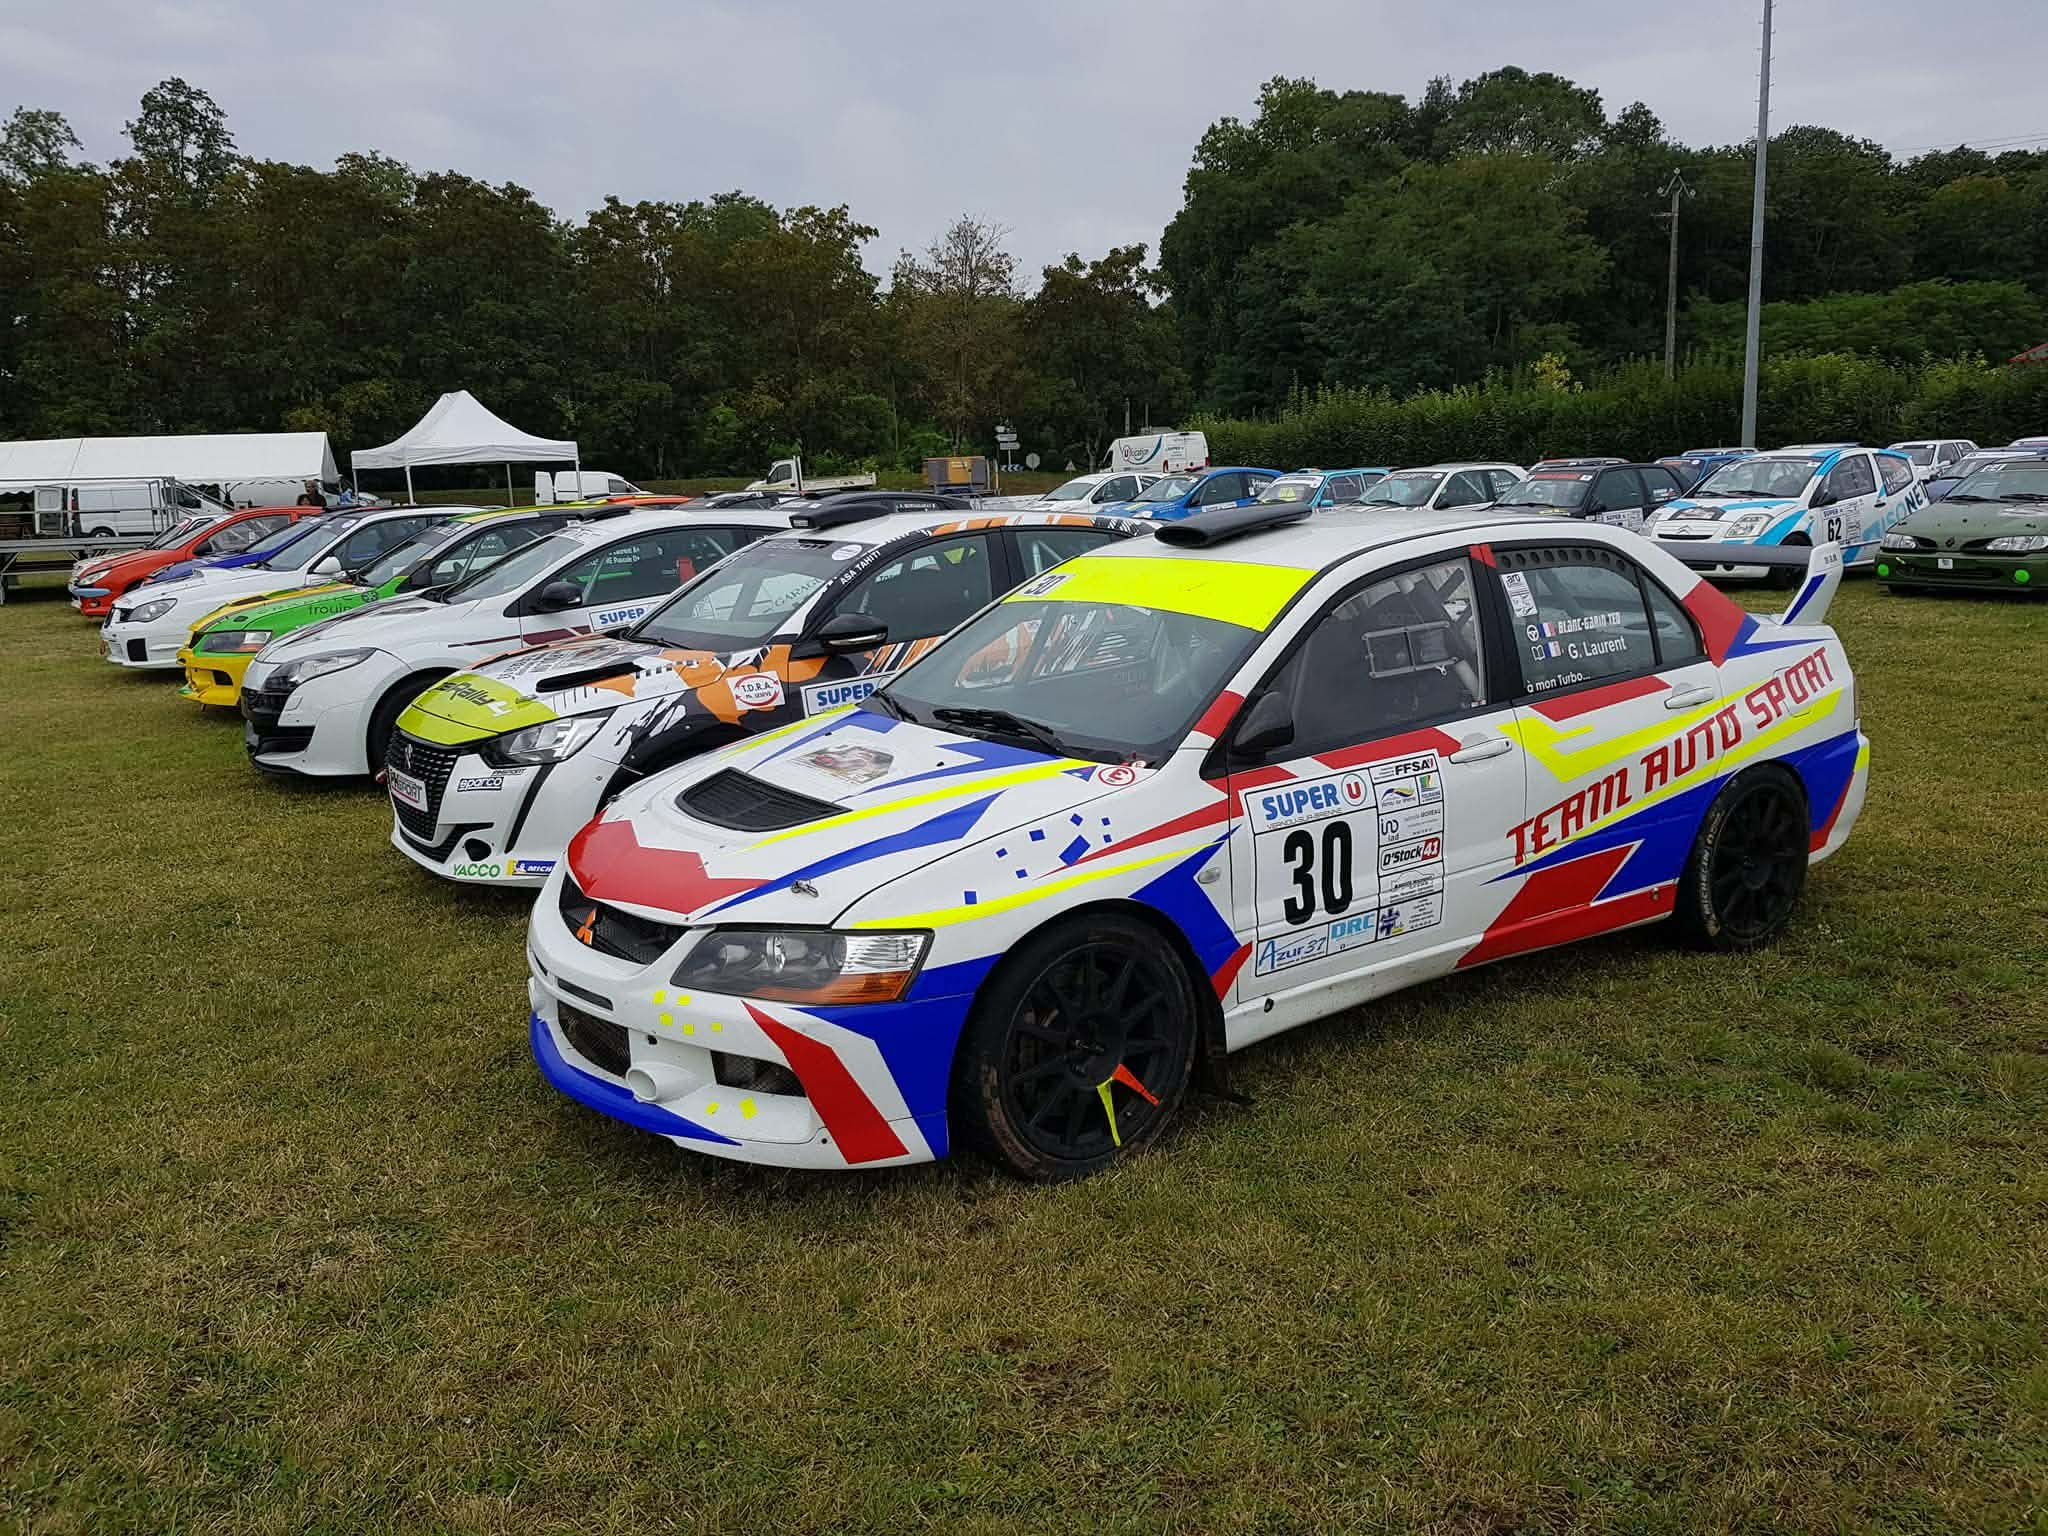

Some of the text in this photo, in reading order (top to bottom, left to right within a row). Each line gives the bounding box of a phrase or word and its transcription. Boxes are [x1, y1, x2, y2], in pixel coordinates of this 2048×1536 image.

[1828, 518, 1841, 541] 62
[840, 569, 856, 585] ASA
[856, 550, 881, 571] TAHITI
[1024, 575, 1067, 594] 30
[1568, 635, 1627, 659] G. Laurent
[817, 683, 874, 707] SUPER
[1526, 680, 1534, 693] à
[1535, 679, 1557, 692] mon
[1395, 760, 1430, 776] FFSA
[1506, 767, 1632, 866] TEAM
[1640, 704, 1742, 793] AUTO
[1745, 647, 1834, 730] SPORT
[458, 777, 503, 790] sparco
[1263, 781, 1361, 821] SUPER U
[1423, 840, 1439, 857] 41
[453, 863, 500, 878] YACCO
[1283, 821, 1353, 925] 30
[1331, 914, 1376, 938] DRC
